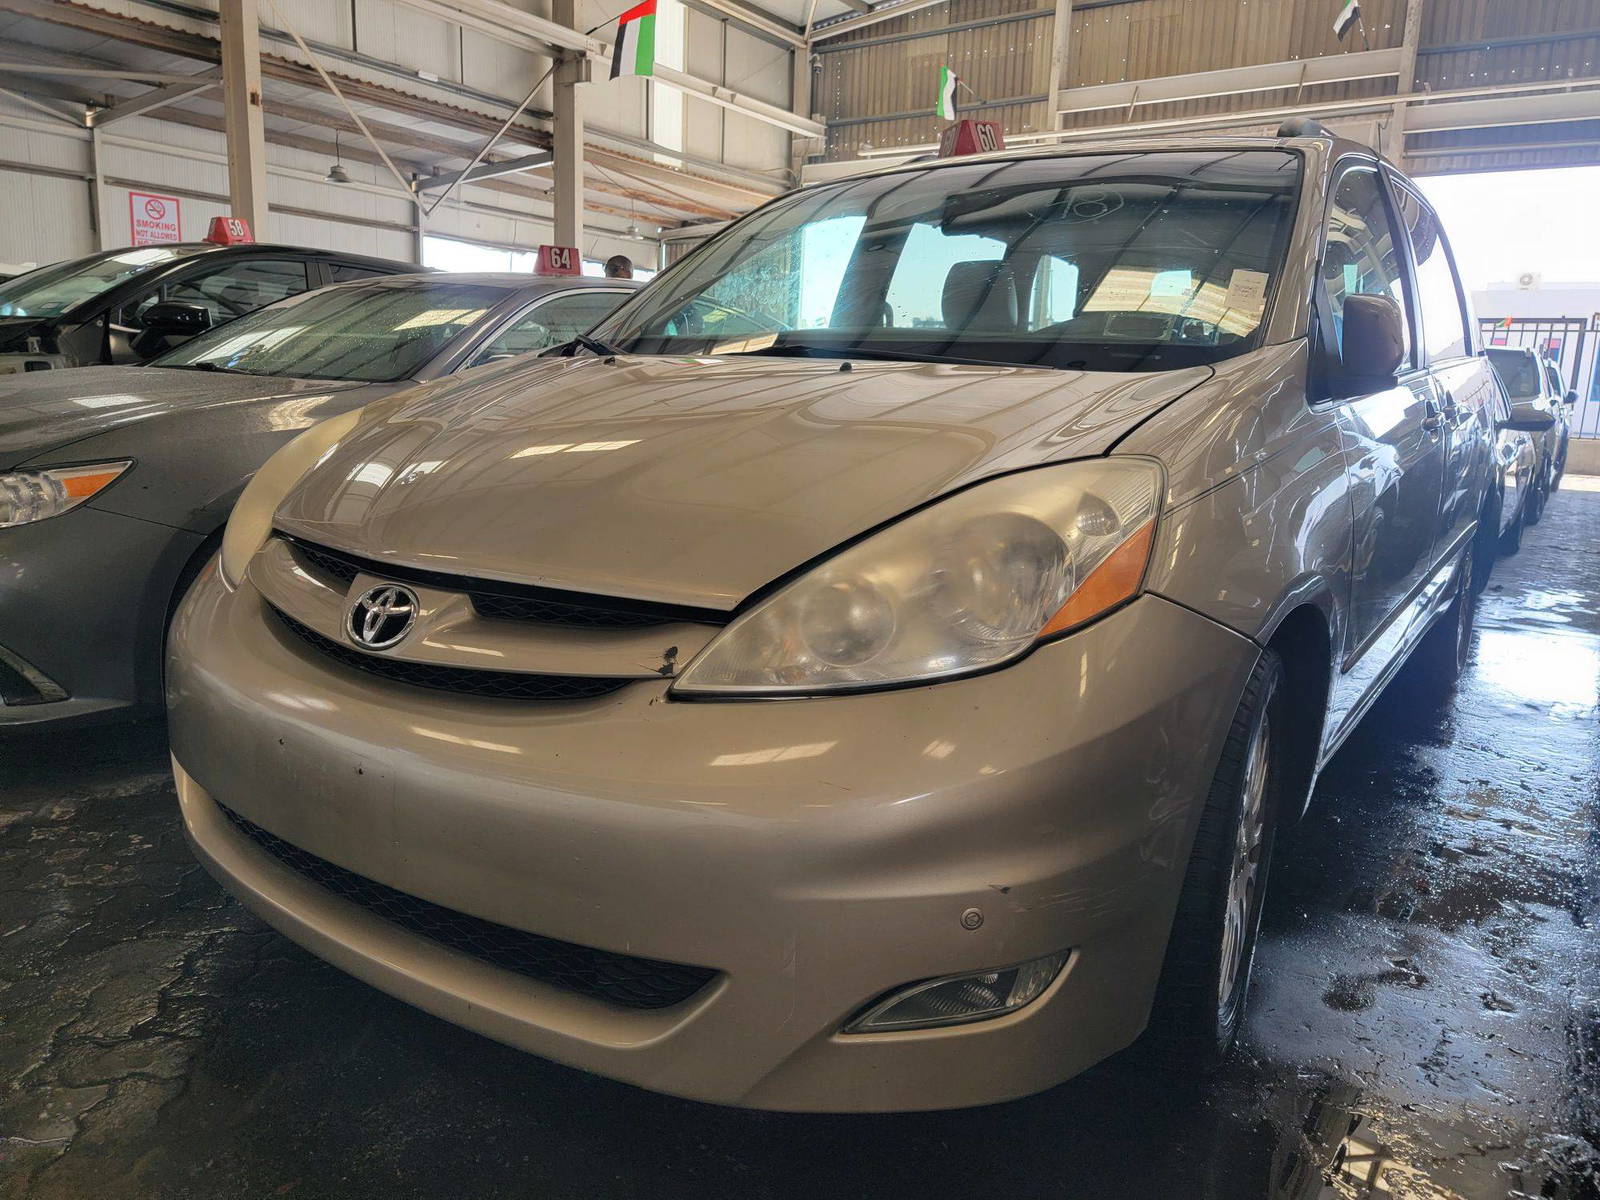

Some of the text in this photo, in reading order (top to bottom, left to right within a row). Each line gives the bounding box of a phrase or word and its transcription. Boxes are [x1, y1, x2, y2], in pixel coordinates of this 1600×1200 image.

[976, 123, 999, 152] 60
[136, 219, 177, 232] SMOKING
[229, 219, 244, 236] 58
[136, 230, 177, 241] NOT ALLOWED
[550, 247, 571, 269] 64
